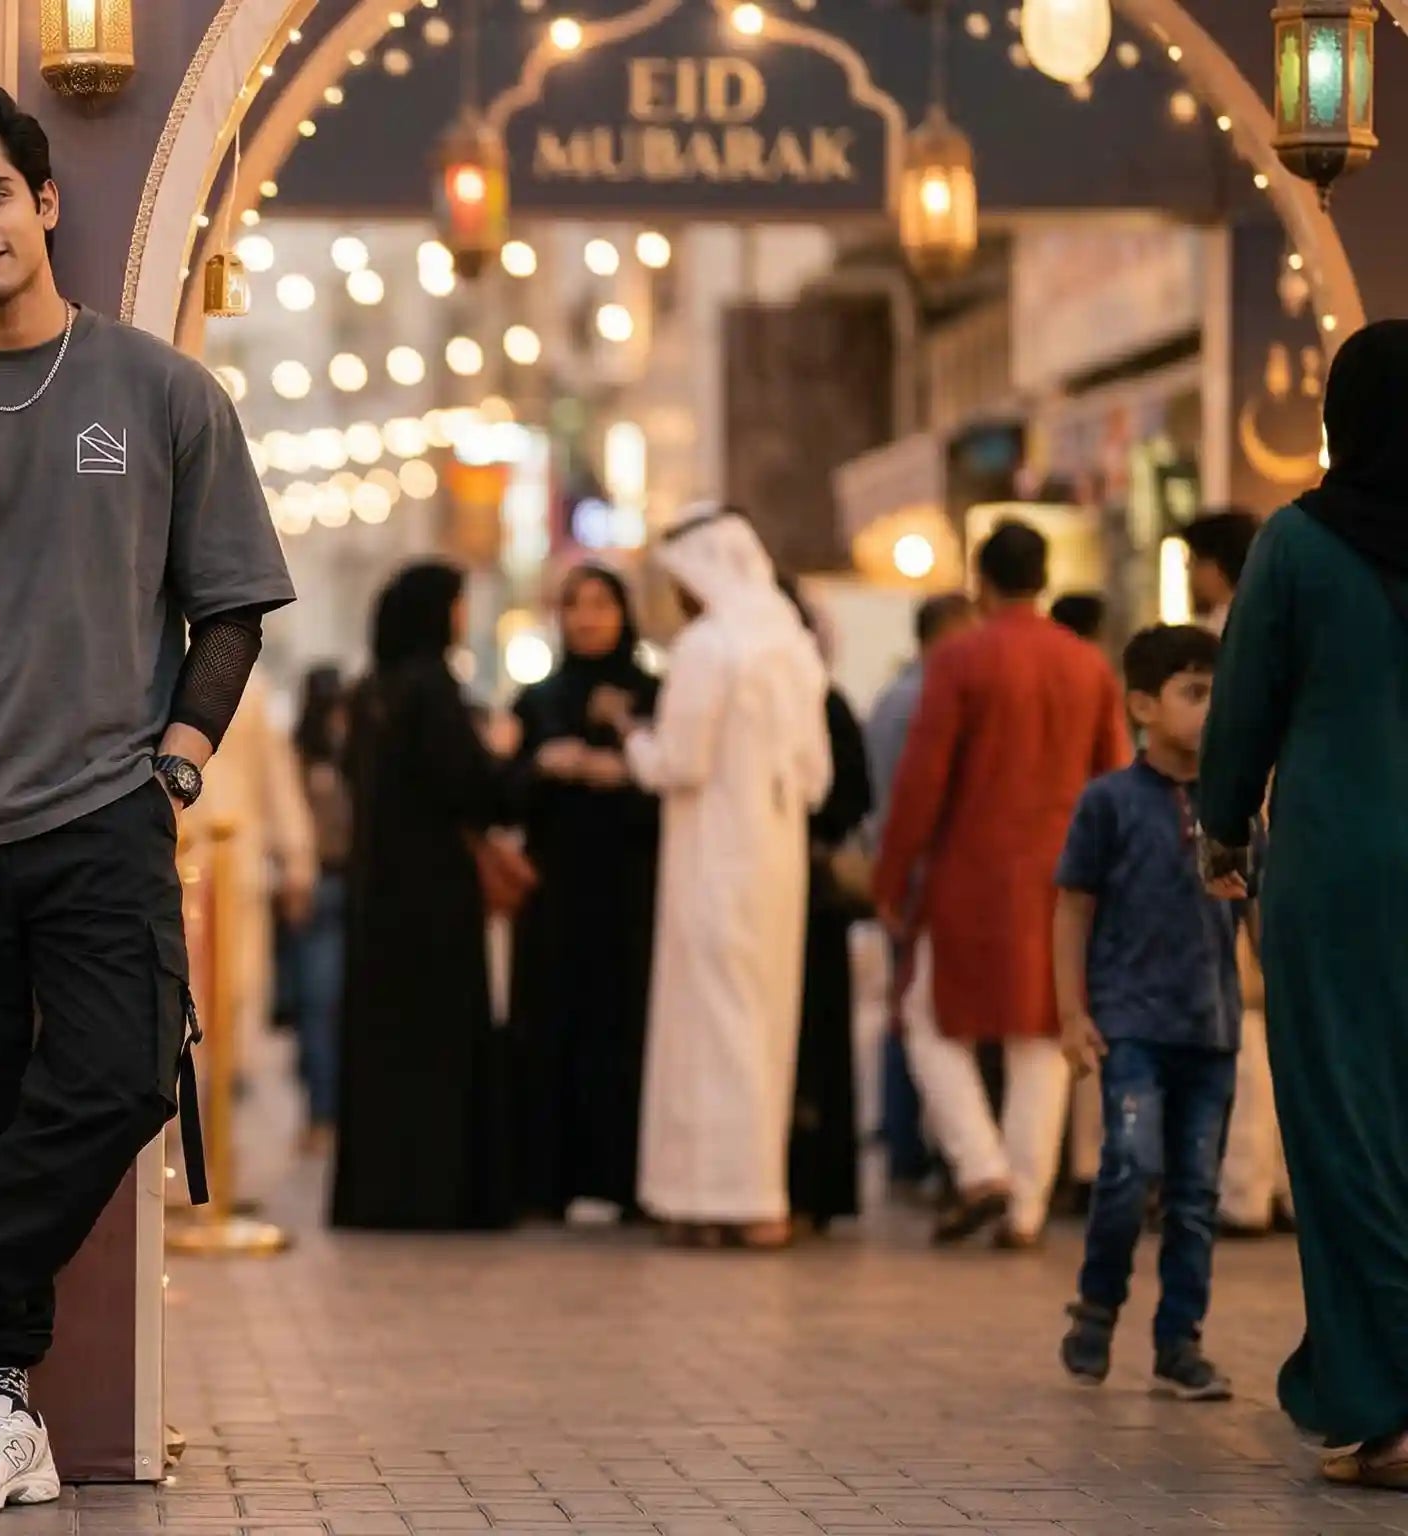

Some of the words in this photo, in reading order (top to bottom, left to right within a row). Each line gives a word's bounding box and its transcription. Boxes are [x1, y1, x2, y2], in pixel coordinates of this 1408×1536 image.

[629, 56, 766, 122] EID
[534, 124, 856, 182] MUBARAK
[3, 1439, 27, 1469] N
